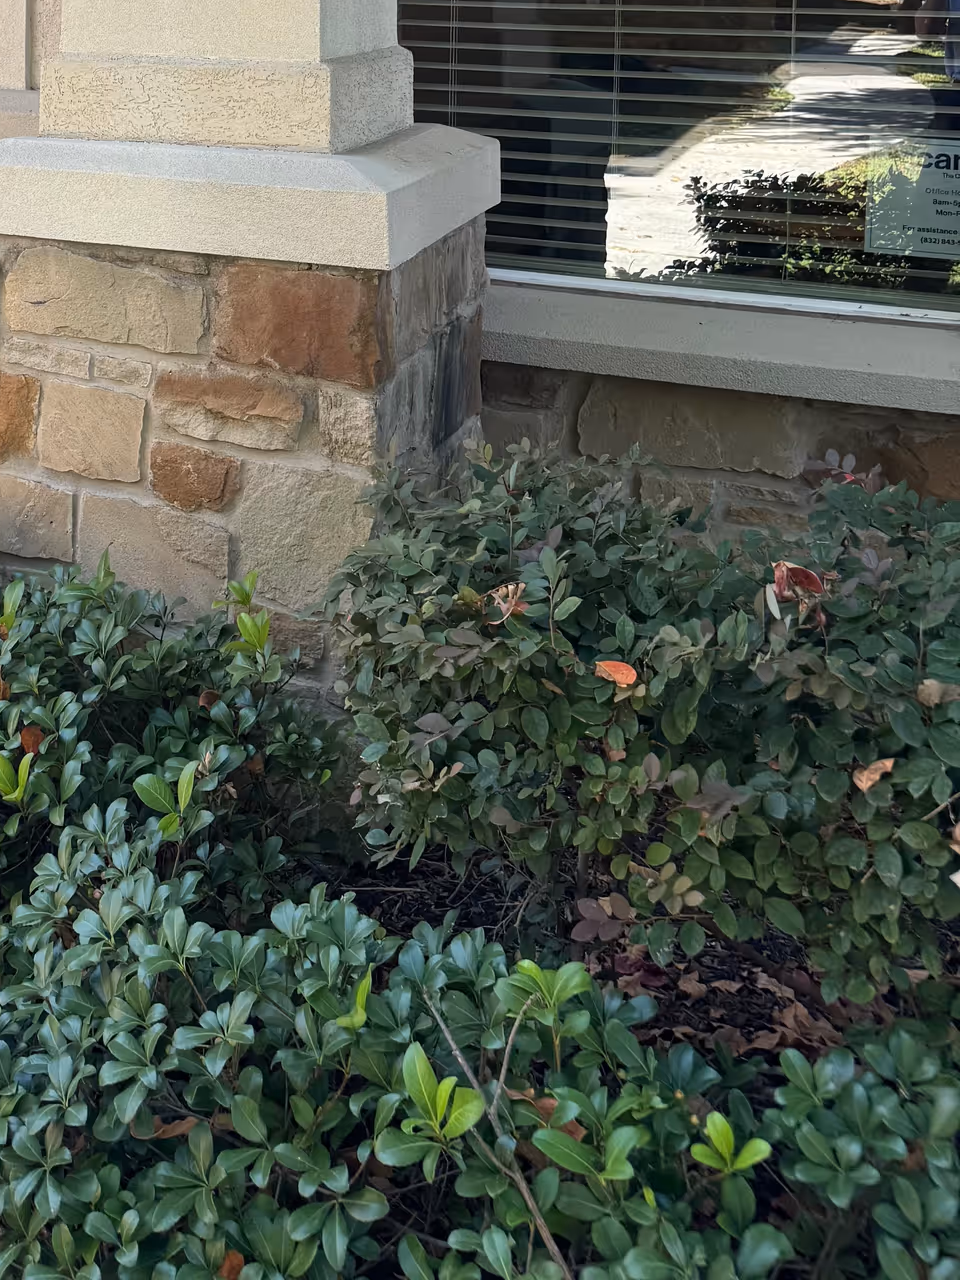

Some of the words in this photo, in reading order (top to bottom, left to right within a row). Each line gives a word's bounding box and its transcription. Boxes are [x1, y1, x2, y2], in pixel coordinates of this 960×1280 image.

[925, 187, 950, 196] Office
[902, 224, 916, 232] For
[917, 226, 958, 235] assistance
[920, 236, 940, 245] (832)
